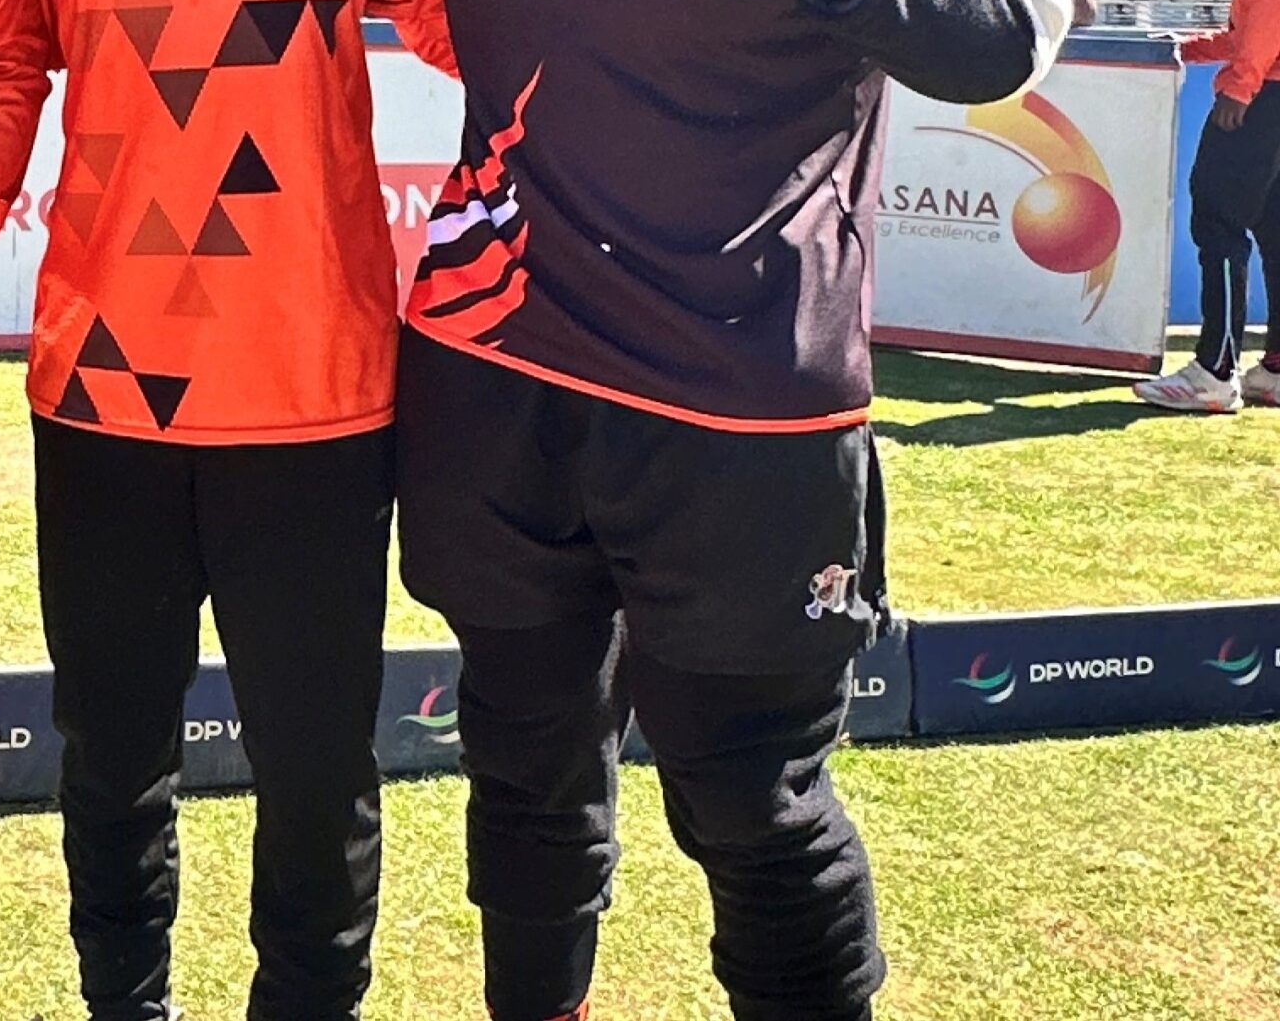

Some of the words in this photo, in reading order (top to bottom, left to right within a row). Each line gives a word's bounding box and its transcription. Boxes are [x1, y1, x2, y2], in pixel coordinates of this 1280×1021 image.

[898, 221, 1000, 243] Excellence
[1030, 662, 1062, 683] DP
[1064, 656, 1154, 680] WORLD
[184, 721, 223, 742] DP
